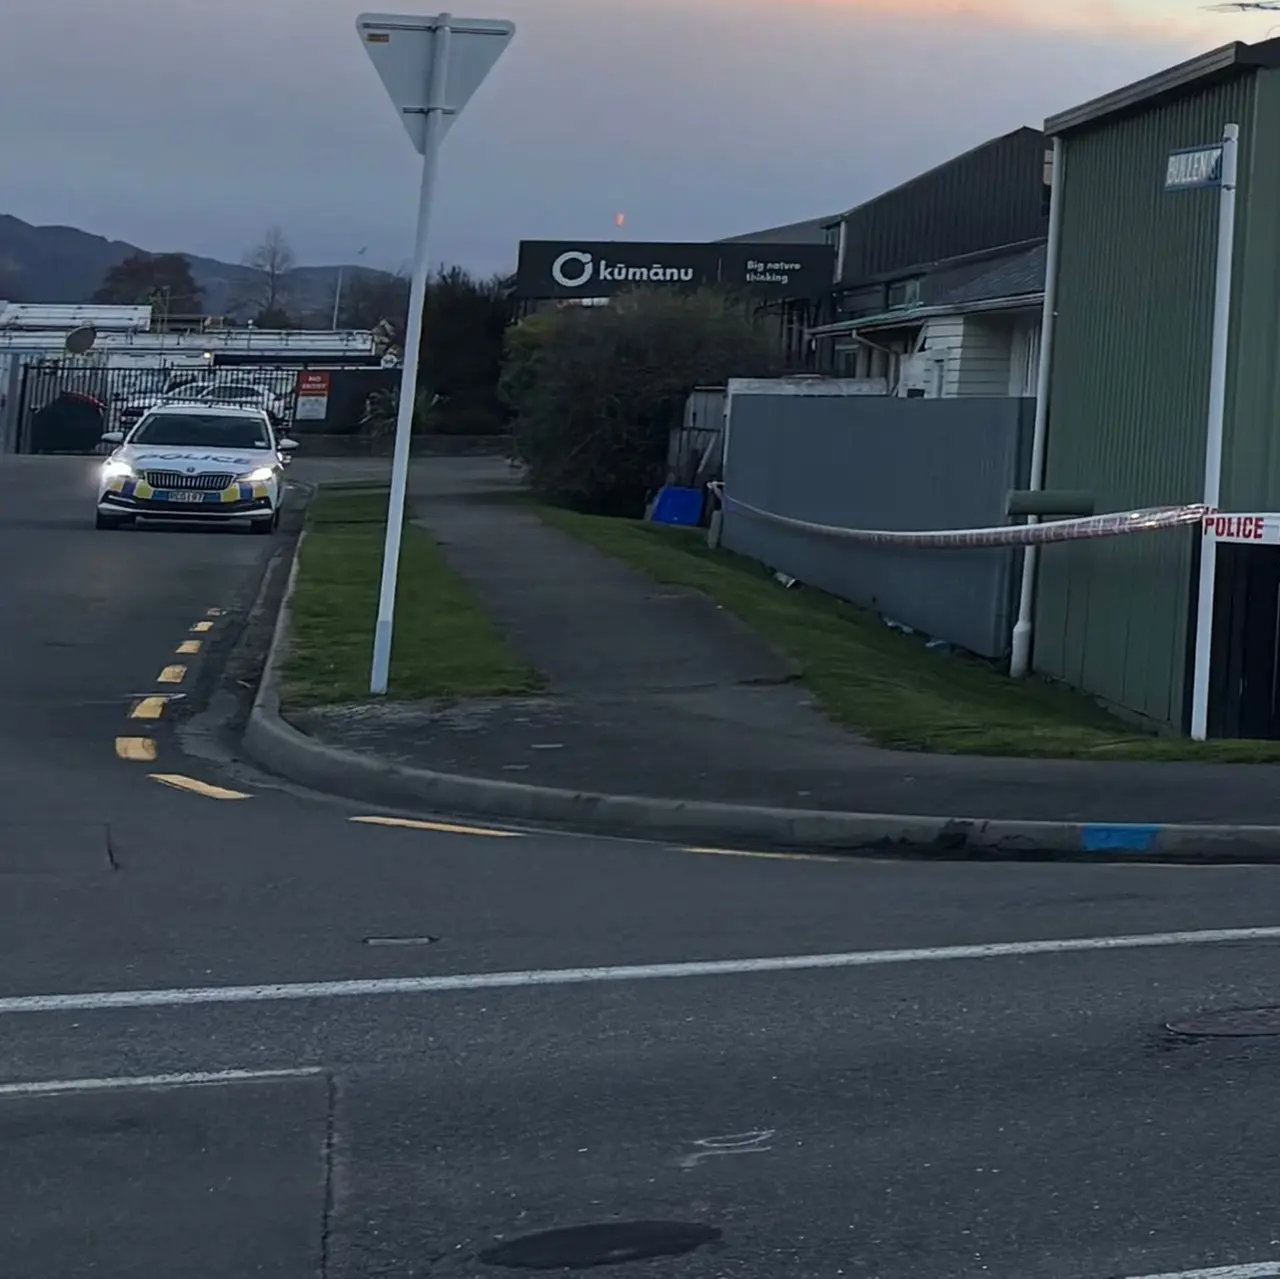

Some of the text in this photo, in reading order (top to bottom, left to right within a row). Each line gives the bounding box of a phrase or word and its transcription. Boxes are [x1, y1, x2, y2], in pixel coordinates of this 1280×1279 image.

[600, 260, 693, 281] kūmānu
[747, 260, 765, 272] Big
[746, 272, 789, 284] thinking
[136, 452, 251, 466] POLICE
[1204, 517, 1264, 540] POLICE
